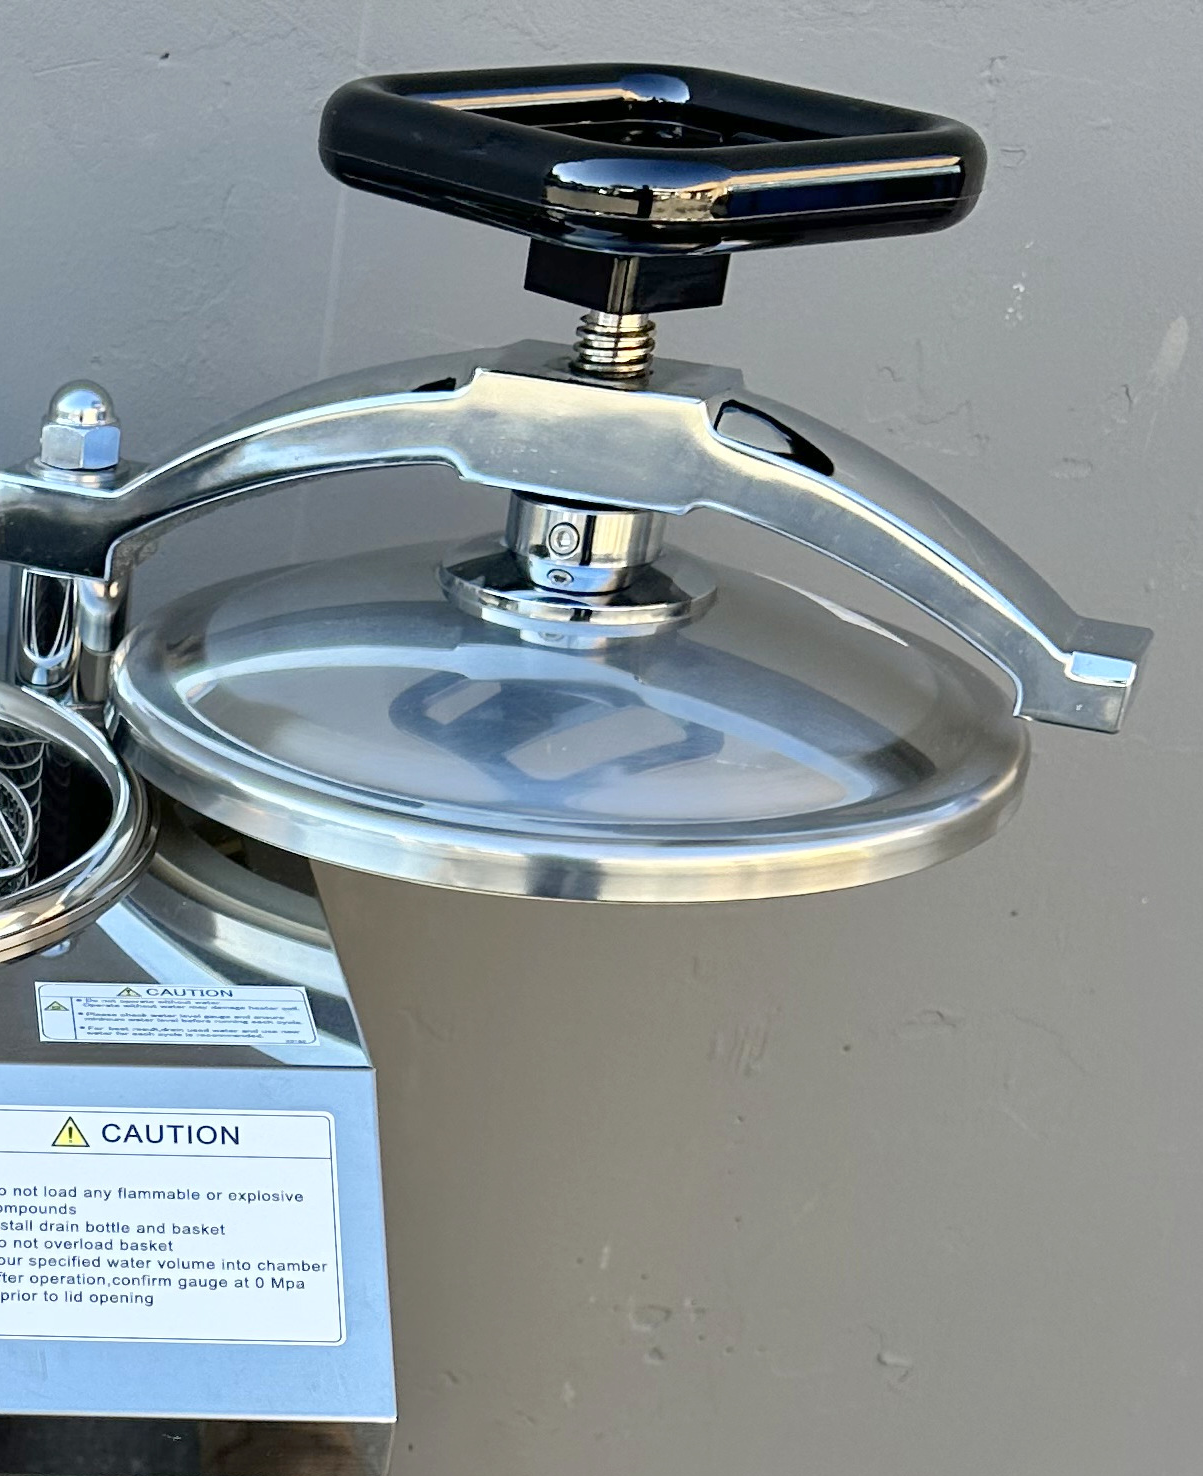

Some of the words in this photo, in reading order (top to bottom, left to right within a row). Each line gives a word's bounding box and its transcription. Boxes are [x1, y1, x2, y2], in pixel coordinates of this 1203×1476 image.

[146, 988, 233, 998] CAUTION
[101, 1123, 240, 1146] CAUTION
[13, 1186, 38, 1197] not
[44, 1186, 77, 1197] load
[84, 1189, 111, 1201] any
[118, 1187, 200, 1200] flammable
[206, 1191, 222, 1200] or
[228, 1190, 303, 1203] explosive
[39, 1220, 79, 1232] drain
[86, 1221, 130, 1233] bottle
[136, 1223, 165, 1234] and
[172, 1223, 225, 1235] basket
[13, 1238, 38, 1249] not
[44, 1238, 113, 1250] overload
[120, 1239, 173, 1251] basket
[29, 1255, 100, 1268] specified
[107, 1257, 151, 1268] water
[157, 1258, 215, 1270] volume
[222, 1259, 251, 1271] into
[257, 1260, 327, 1272] chamber
[178, 1278, 228, 1290] gauge
[234, 1277, 249, 1288] at
[256, 1277, 264, 1288] 0
[272, 1277, 305, 1291] Mpa
[1, 1290, 37, 1303] prior
[44, 1291, 58, 1302] to
[65, 1291, 82, 1302] lid
[89, 1292, 153, 1306] opening
